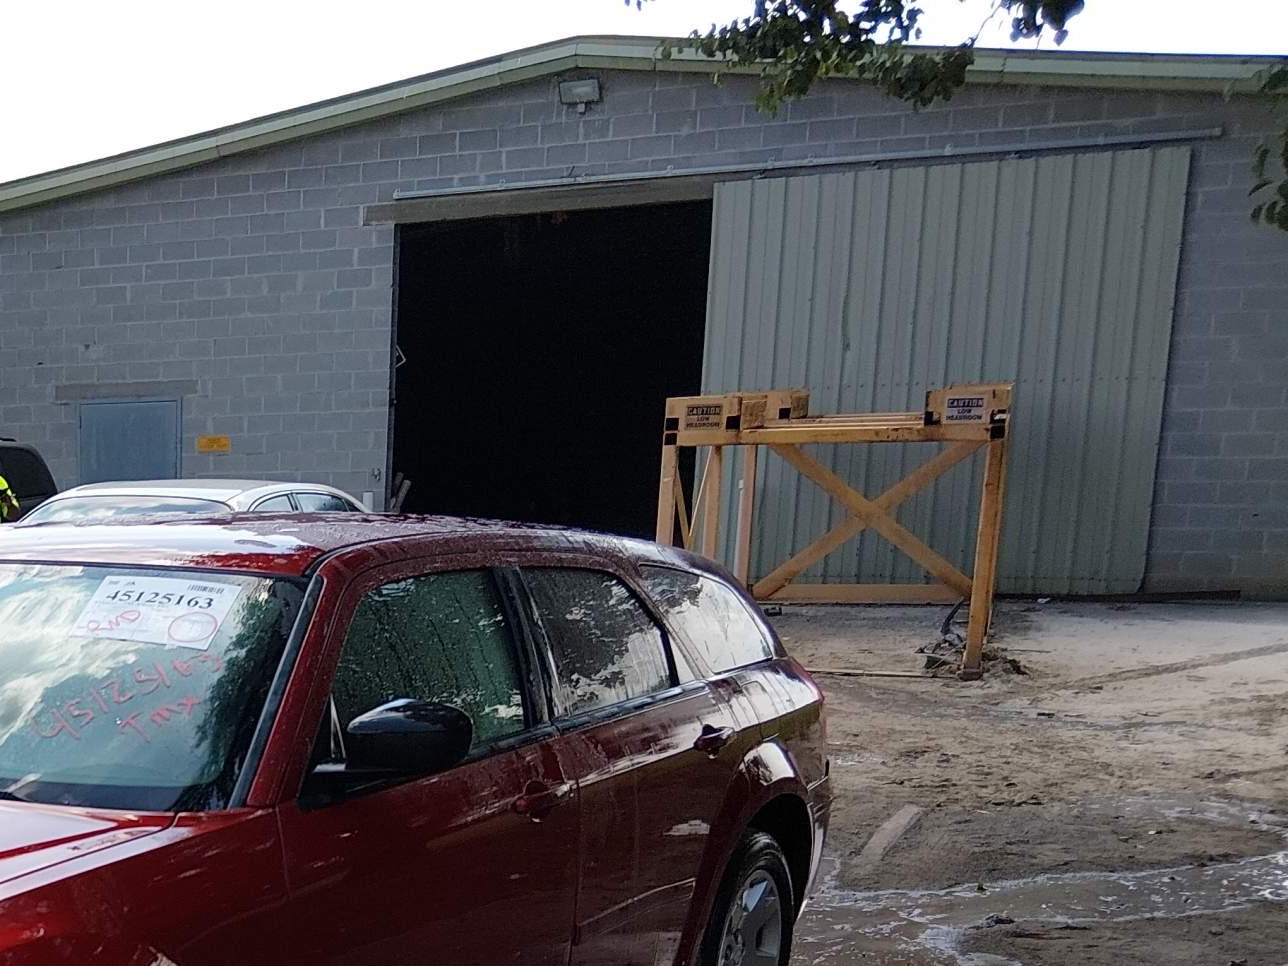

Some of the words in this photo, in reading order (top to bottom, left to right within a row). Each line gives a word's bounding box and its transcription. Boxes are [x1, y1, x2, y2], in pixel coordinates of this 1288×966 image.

[948, 399, 983, 407] CAUTION
[688, 407, 720, 415] CAUTION
[106, 590, 214, 609] 45125163
[31, 653, 224, 740] 45125163
